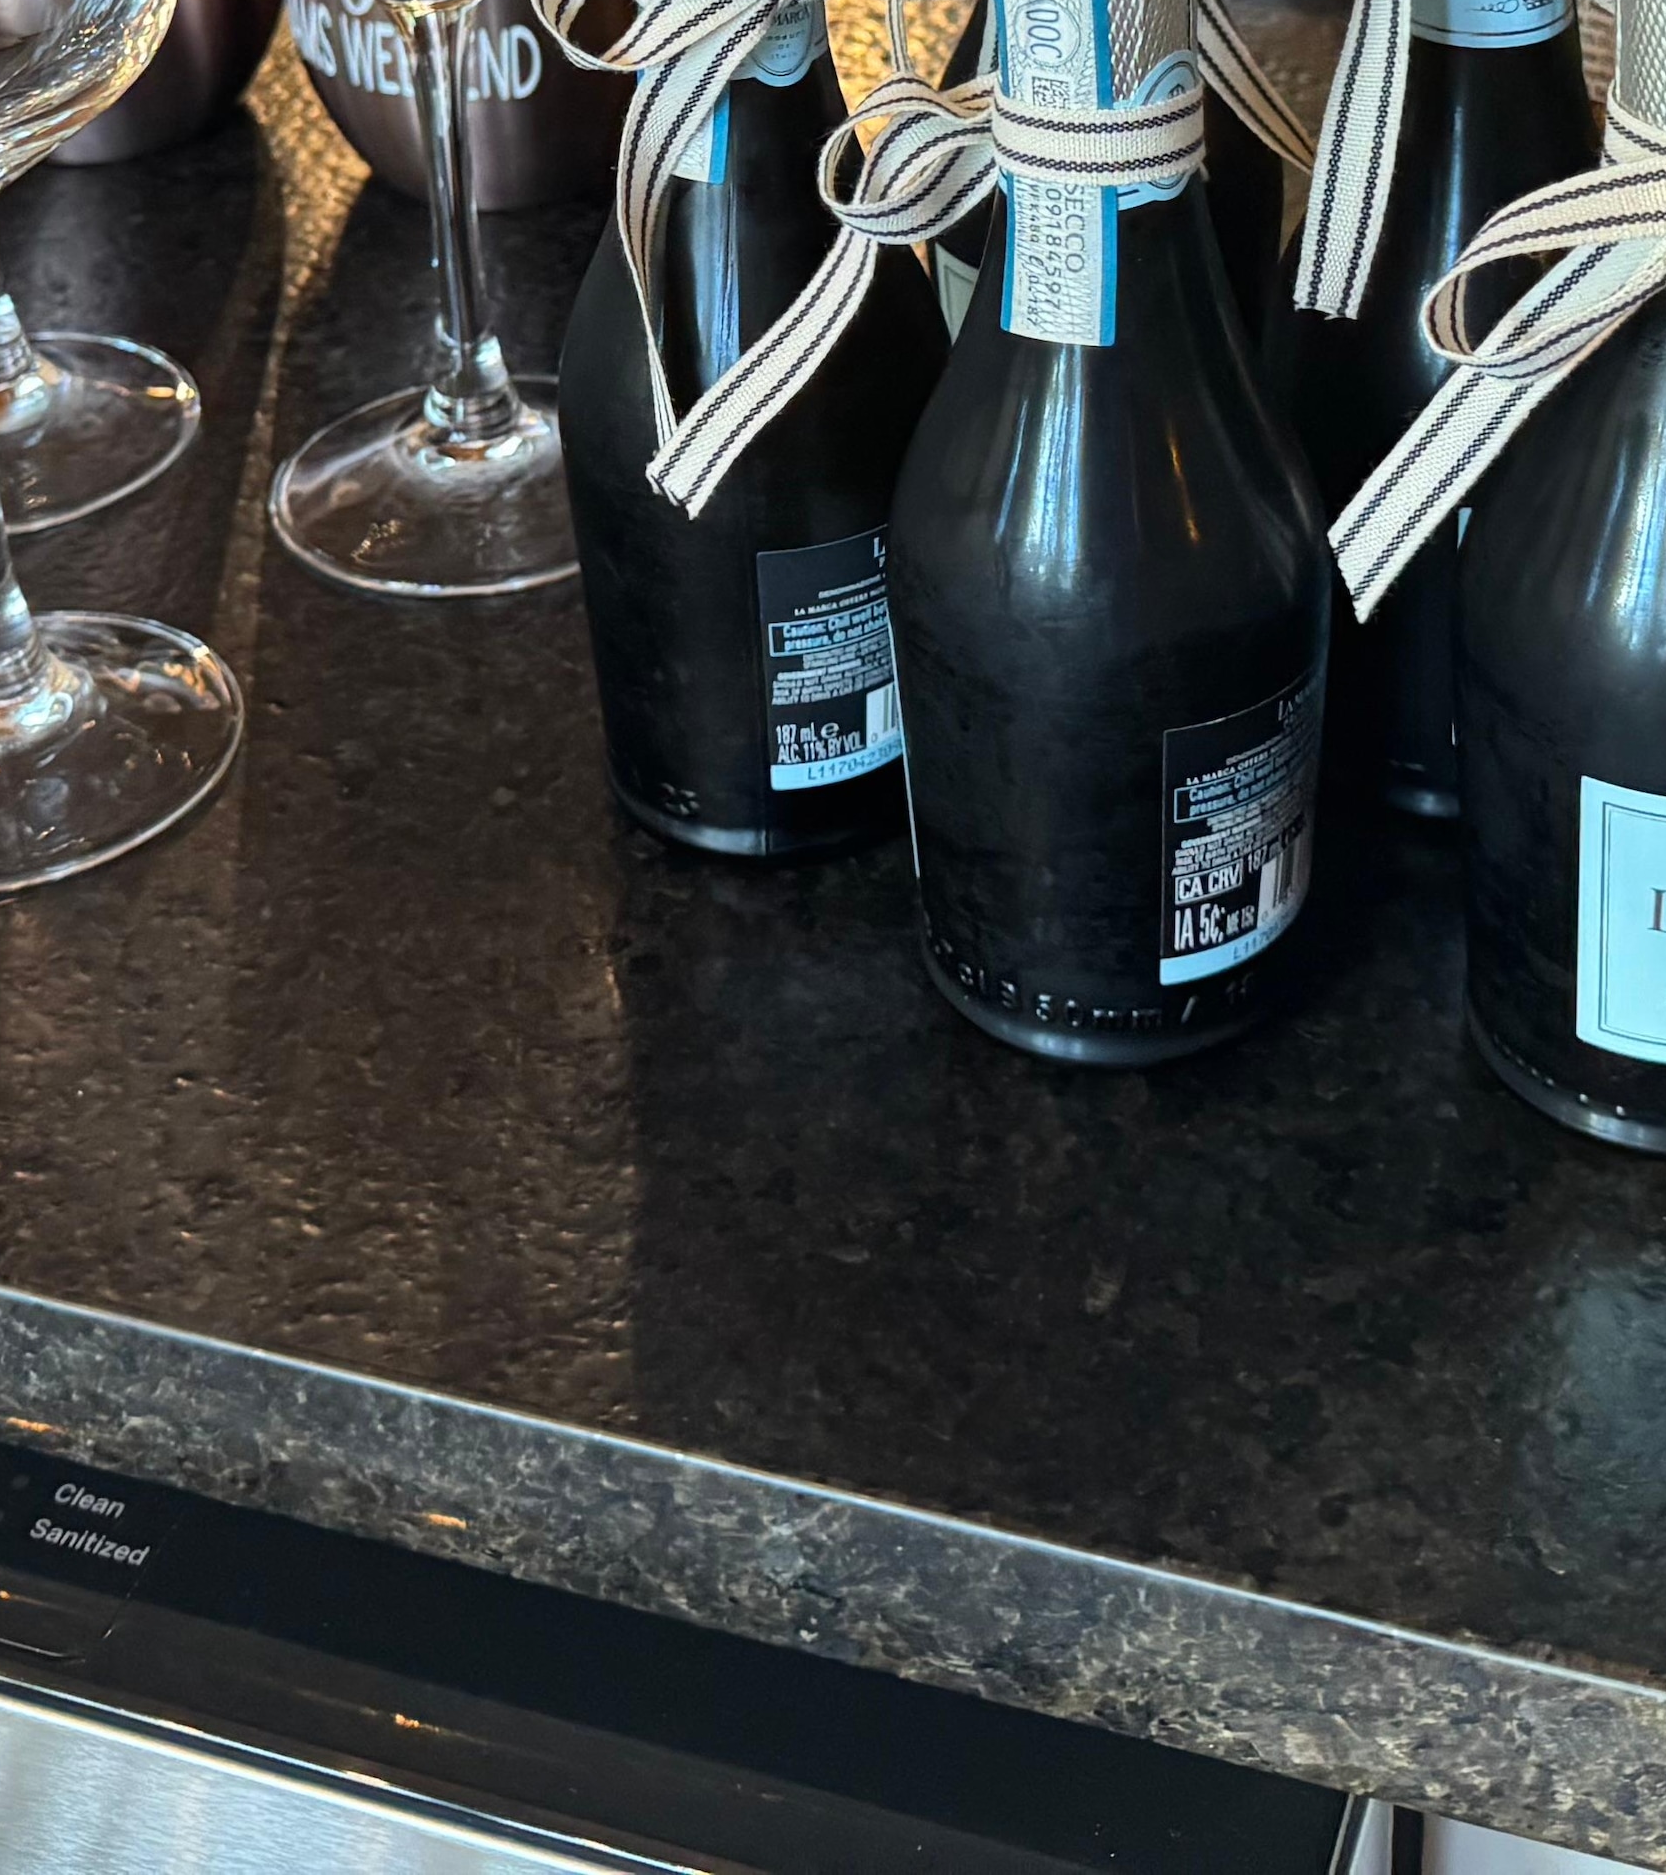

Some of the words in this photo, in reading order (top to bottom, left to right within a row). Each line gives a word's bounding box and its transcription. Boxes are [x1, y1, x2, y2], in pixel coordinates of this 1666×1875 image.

[1026, 8, 1064, 60] DOC
[1065, 182, 1085, 274] SECCO
[776, 723, 797, 745] 187
[1179, 878, 1203, 900] CA
[1208, 866, 1240, 894] CRV
[1174, 907, 1195, 951] IA
[53, 1481, 127, 1520] Clean
[28, 1517, 151, 1568] Sanitized
